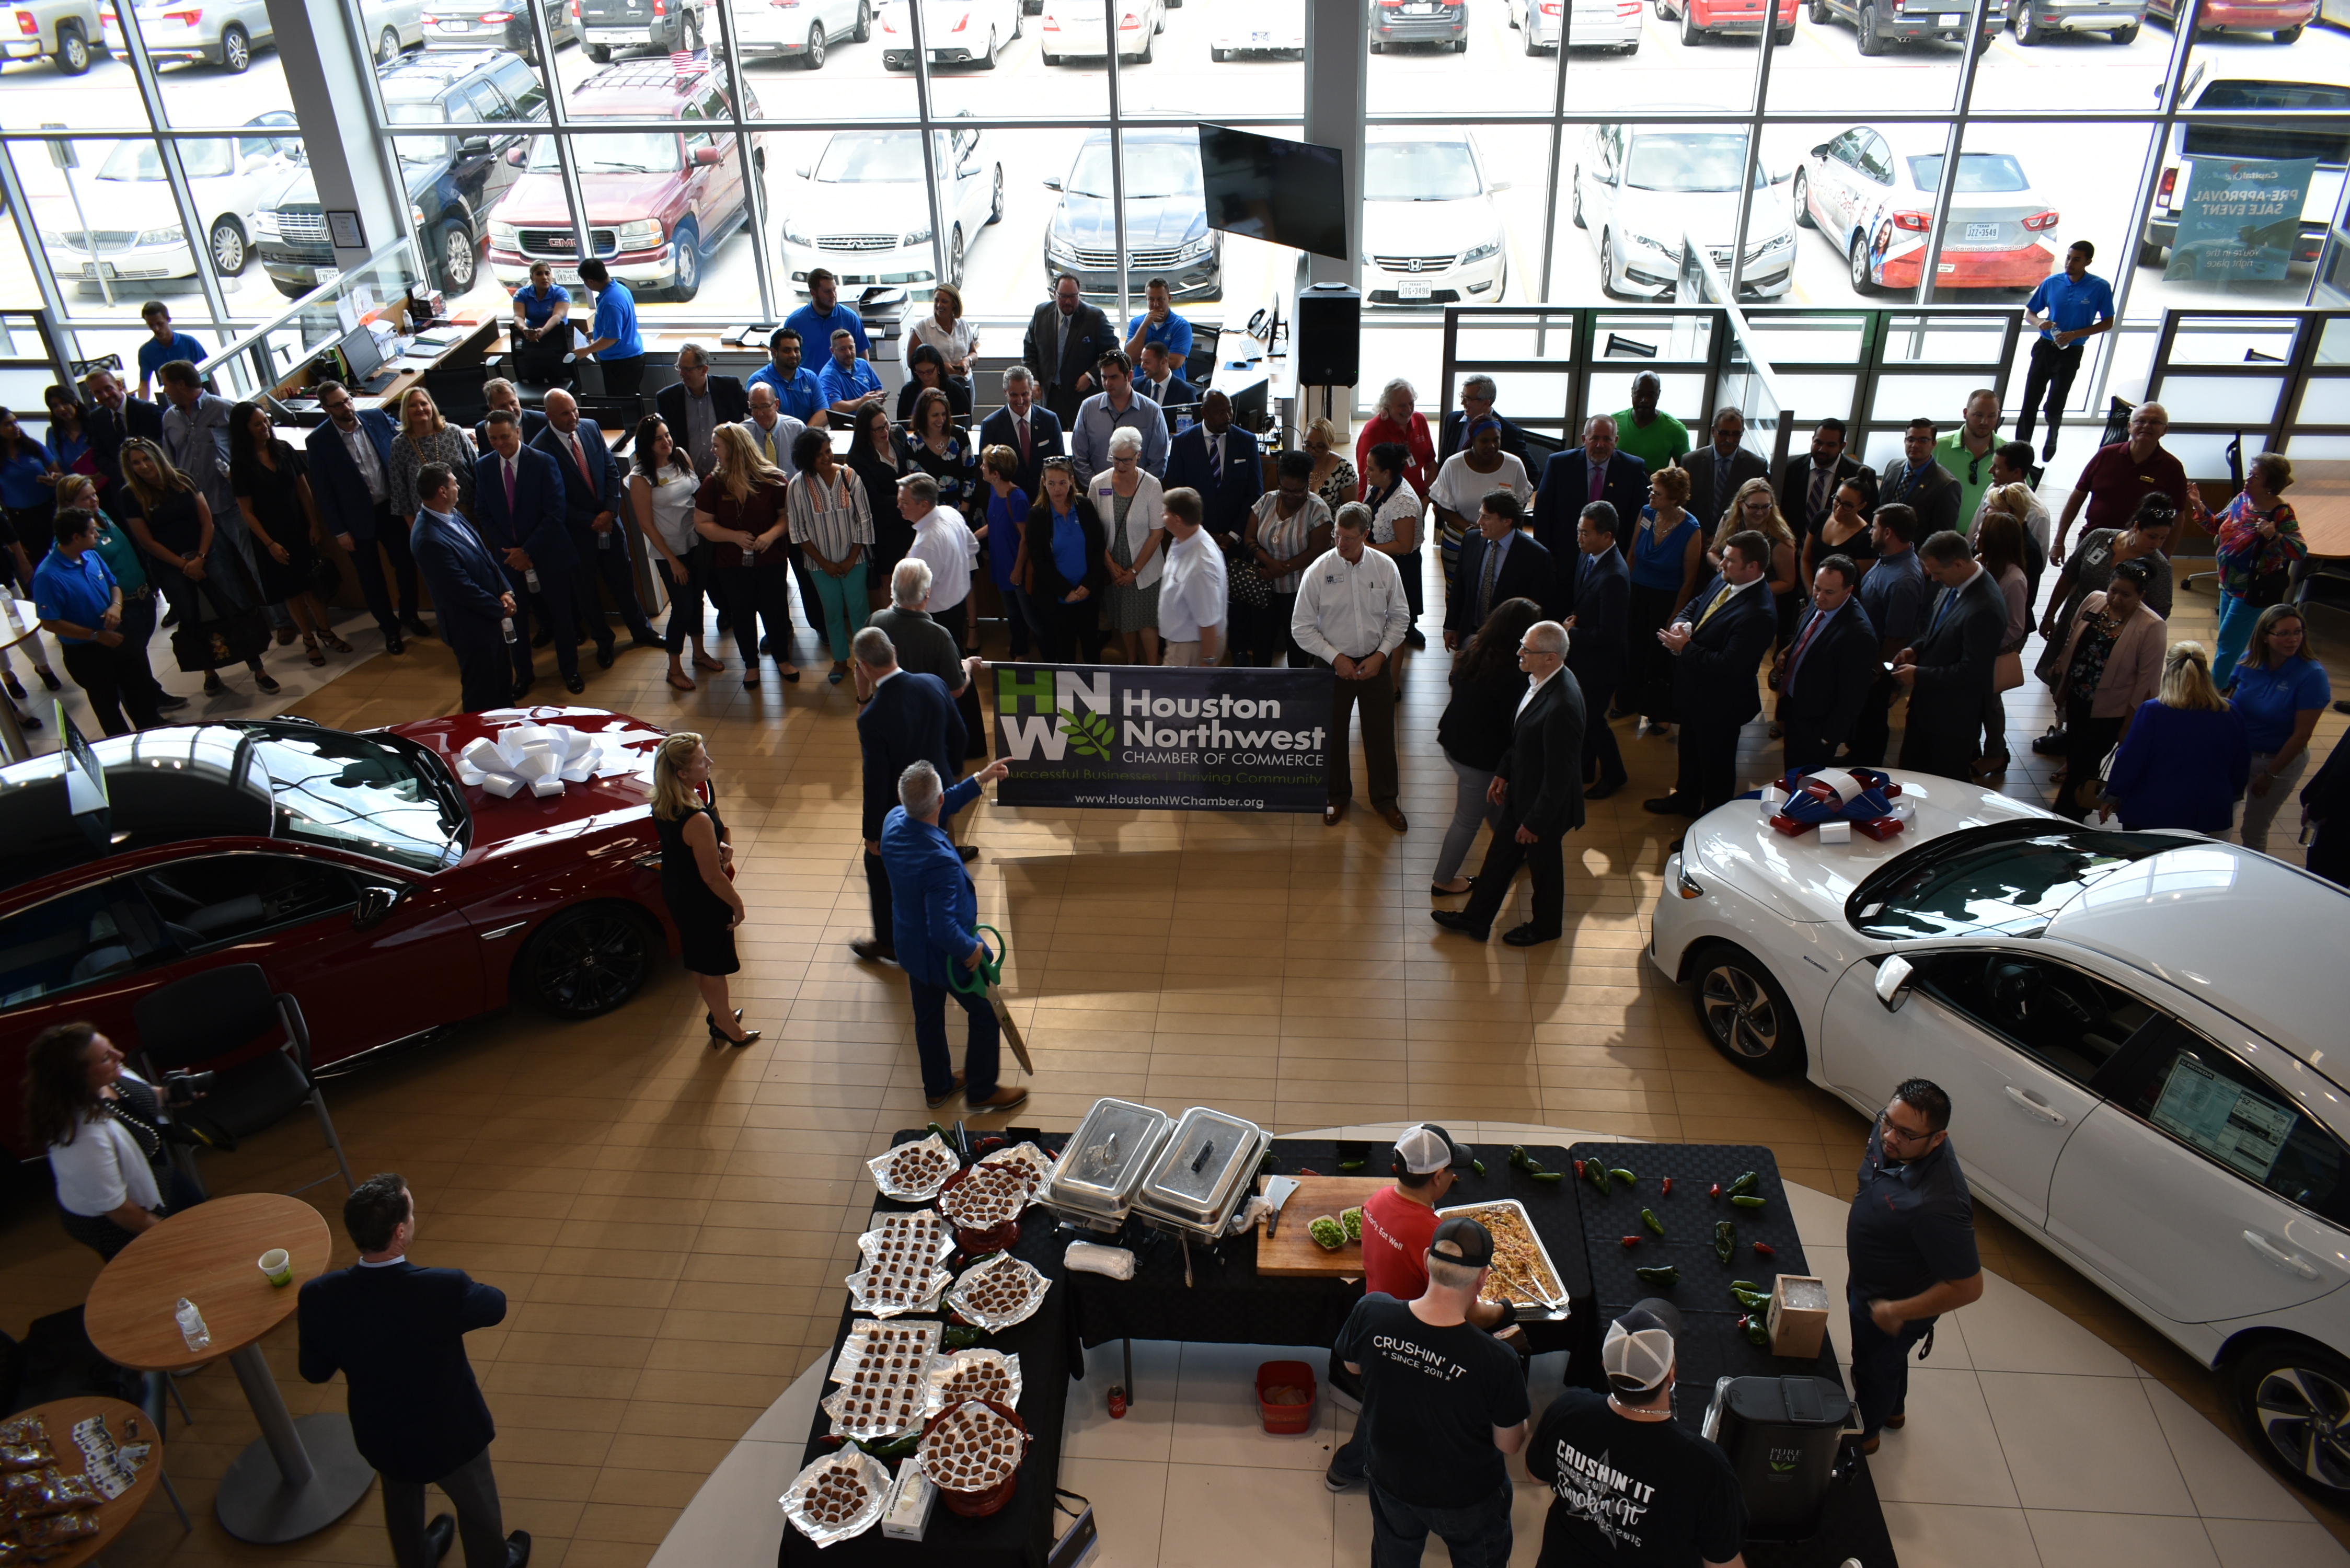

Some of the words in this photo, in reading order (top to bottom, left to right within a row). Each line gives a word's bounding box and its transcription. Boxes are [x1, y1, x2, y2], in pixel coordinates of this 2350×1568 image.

[1123, 689, 1281, 719] Houston
[1123, 719, 1326, 750] Northwest
[1122, 751, 1199, 765] CHAMBER
[1204, 753, 1226, 765] OF
[1231, 753, 1323, 766] COMMERCE
[1084, 770, 1157, 781] Businesses
[1177, 771, 1230, 785] Thriving
[1236, 773, 1321, 786] Community
[1075, 794, 1264, 809] www.HoustonNWChamber.org
[2186, 1063, 2213, 1078] HONDA
[1379, 1227, 1388, 1240] Eat
[1389, 1235, 1403, 1250] Well
[1374, 1335, 1446, 1366] CRUSHIN'
[1449, 1364, 1467, 1378] IT
[1390, 1352, 1420, 1368] SINCE
[1424, 1365, 1443, 1378] 2011
[1556, 1457, 1582, 1483] SINCE
[1557, 1439, 1634, 1492] CRUSHIN'
[1633, 1482, 1655, 1503] IT
[889, 1478, 904, 1511] Companions
[1553, 1471, 1615, 1517] Smokin'
[1616, 1498, 1647, 1526] It
[1584, 1512, 1612, 1531] SINCE
[1616, 1528, 1641, 1547] 2015
